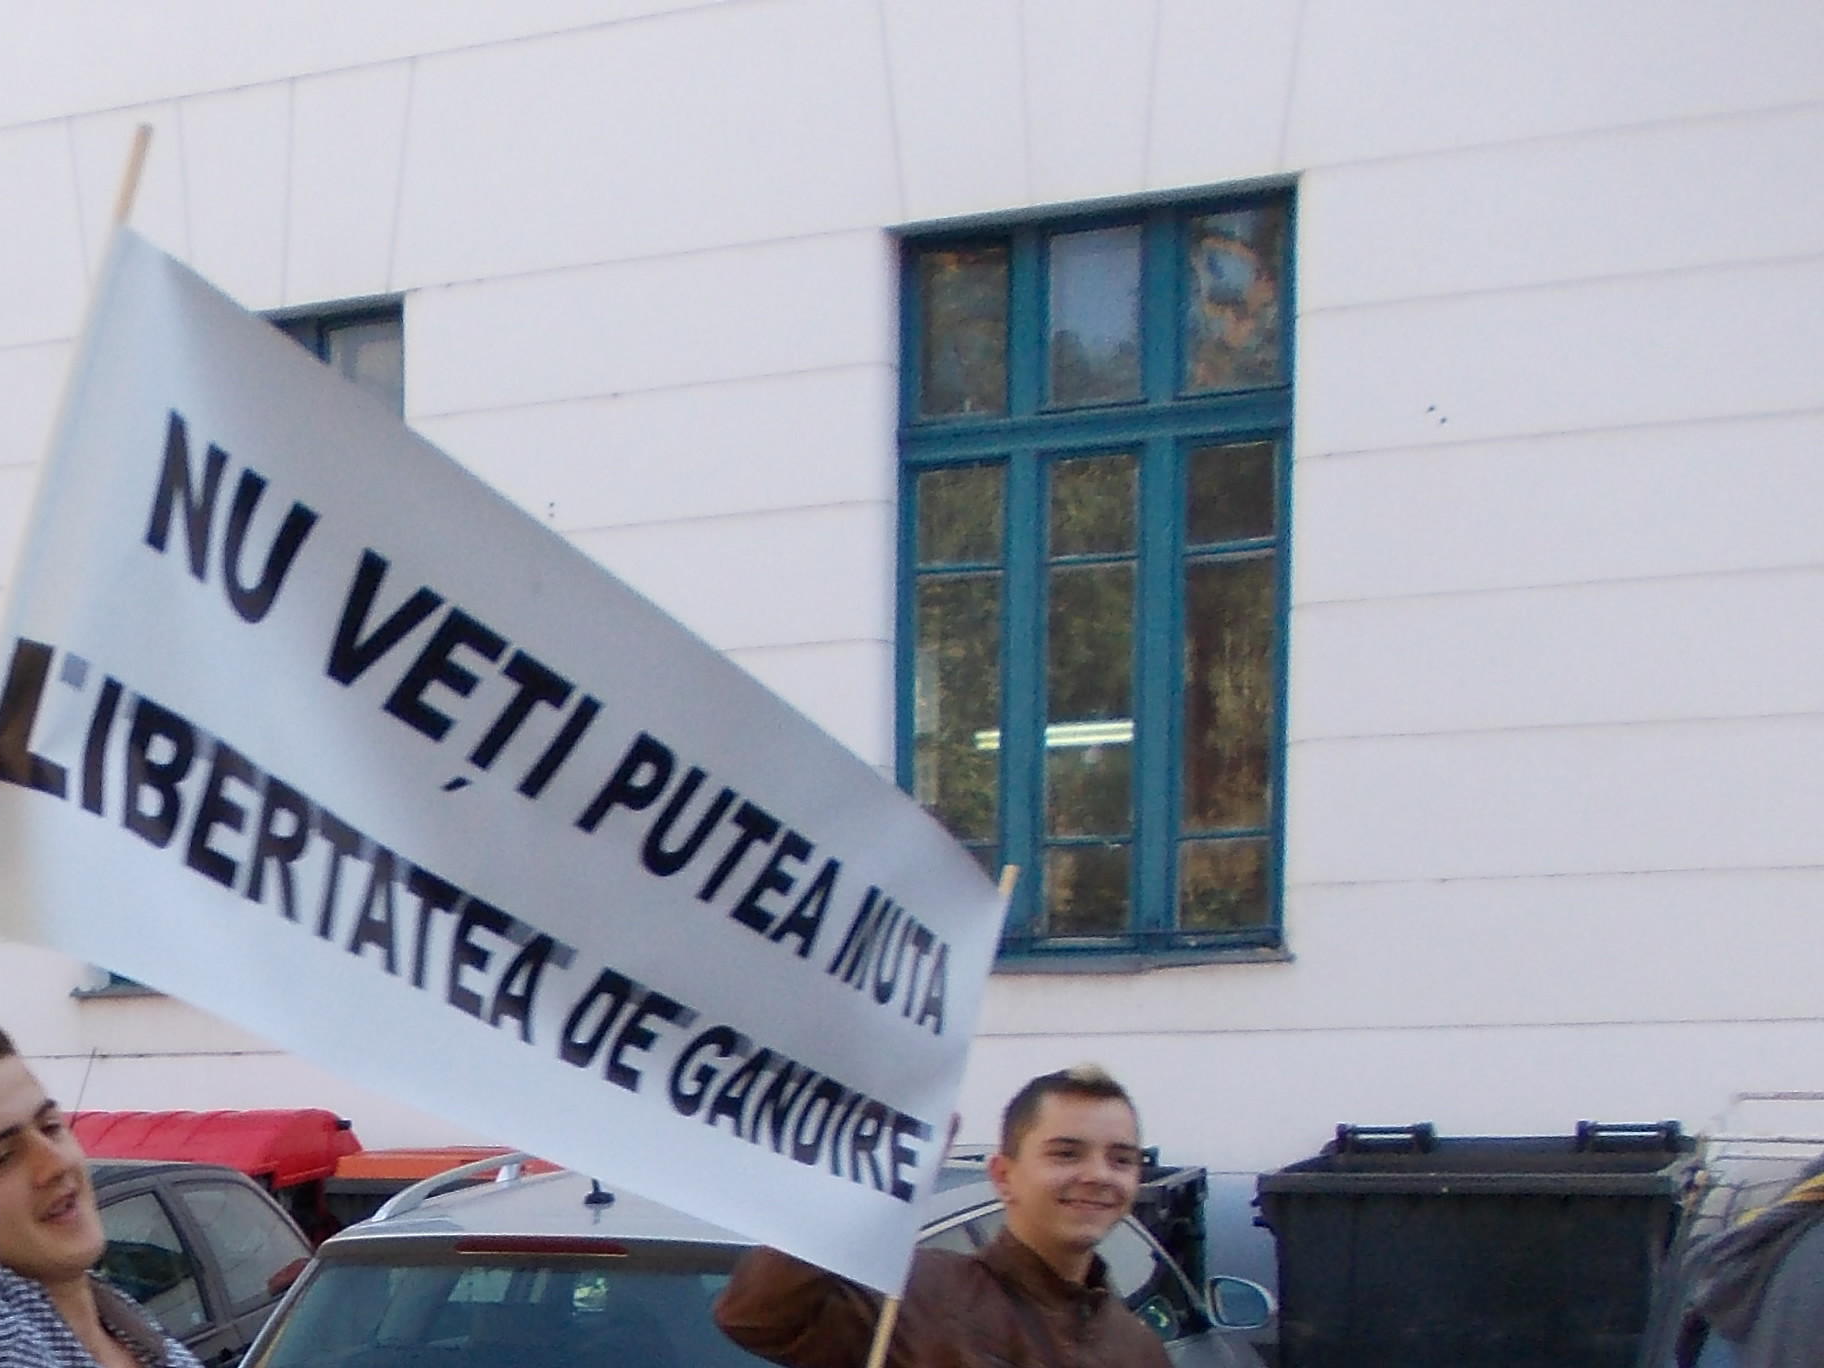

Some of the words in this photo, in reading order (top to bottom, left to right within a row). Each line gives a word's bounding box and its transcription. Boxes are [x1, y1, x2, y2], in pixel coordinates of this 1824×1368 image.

[143, 409, 319, 624] NU
[326, 546, 600, 802] VEȚI
[574, 730, 843, 960] PUTEA
[558, 966, 698, 1092] DE
[669, 1022, 934, 1204] GANDIRE
